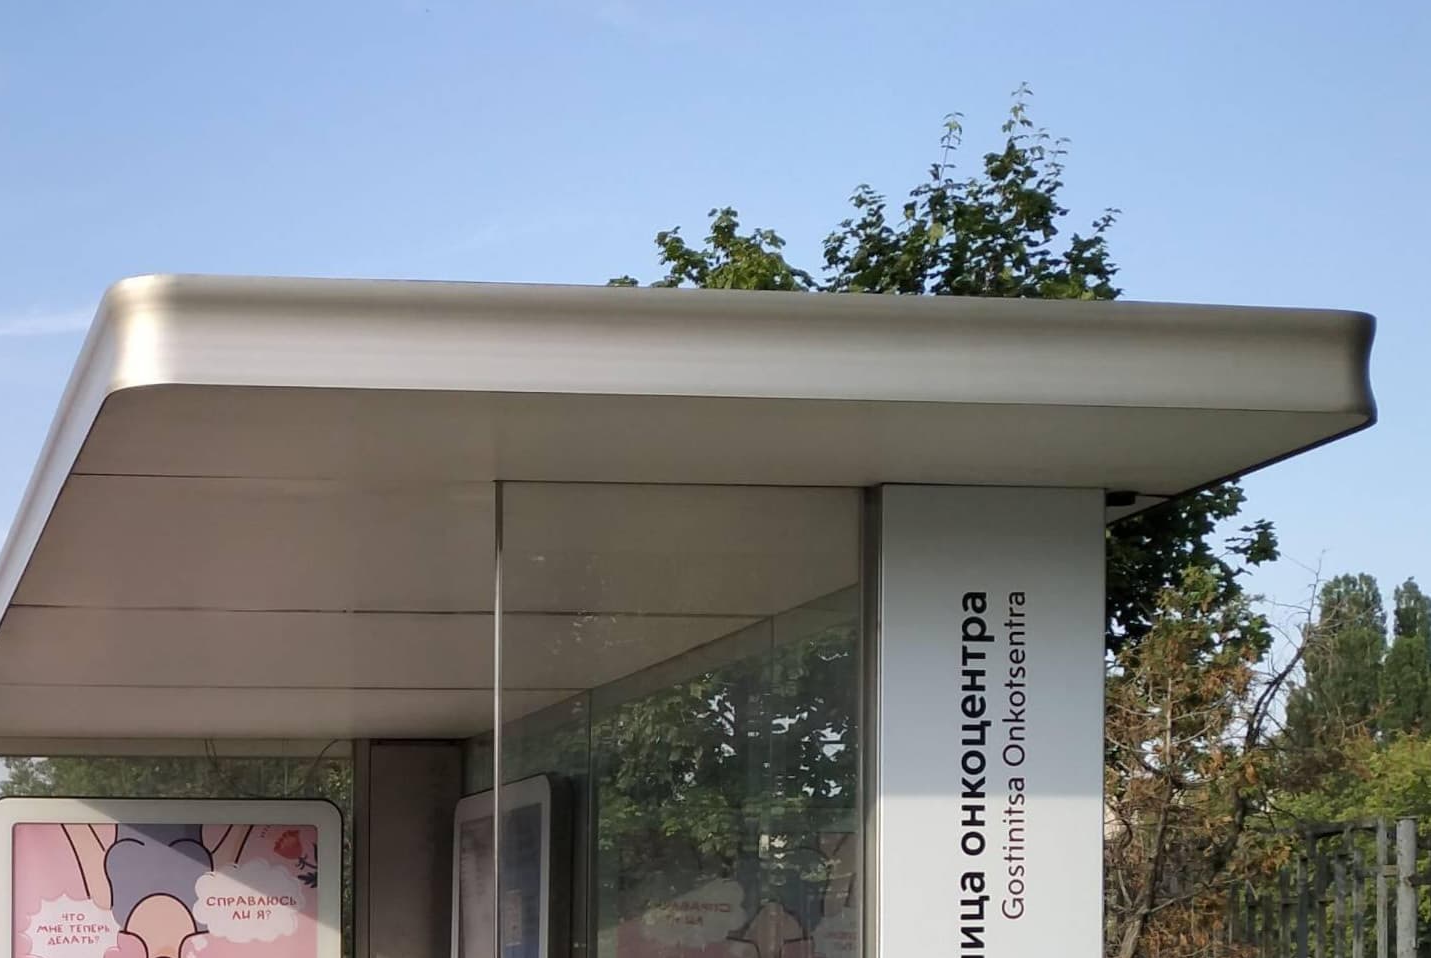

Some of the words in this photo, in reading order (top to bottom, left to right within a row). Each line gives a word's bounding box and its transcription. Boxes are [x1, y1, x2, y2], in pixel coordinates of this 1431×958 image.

[1002, 590, 1026, 767] Onkotsentra
[960, 590, 995, 857] онкоцентра
[1001, 776, 1025, 920] Gostinitsa
[206, 895, 297, 907] СПРАВЛЮСЬ
[62, 913, 85, 921] ЧТО
[232, 911, 250, 920] ЛИ
[257, 910, 272, 920] Я?
[37, 925, 63, 933] МНЕ
[70, 925, 110, 933] ТЕПЕРЬ
[48, 935, 100, 945] ДЕЛАТЬ?
